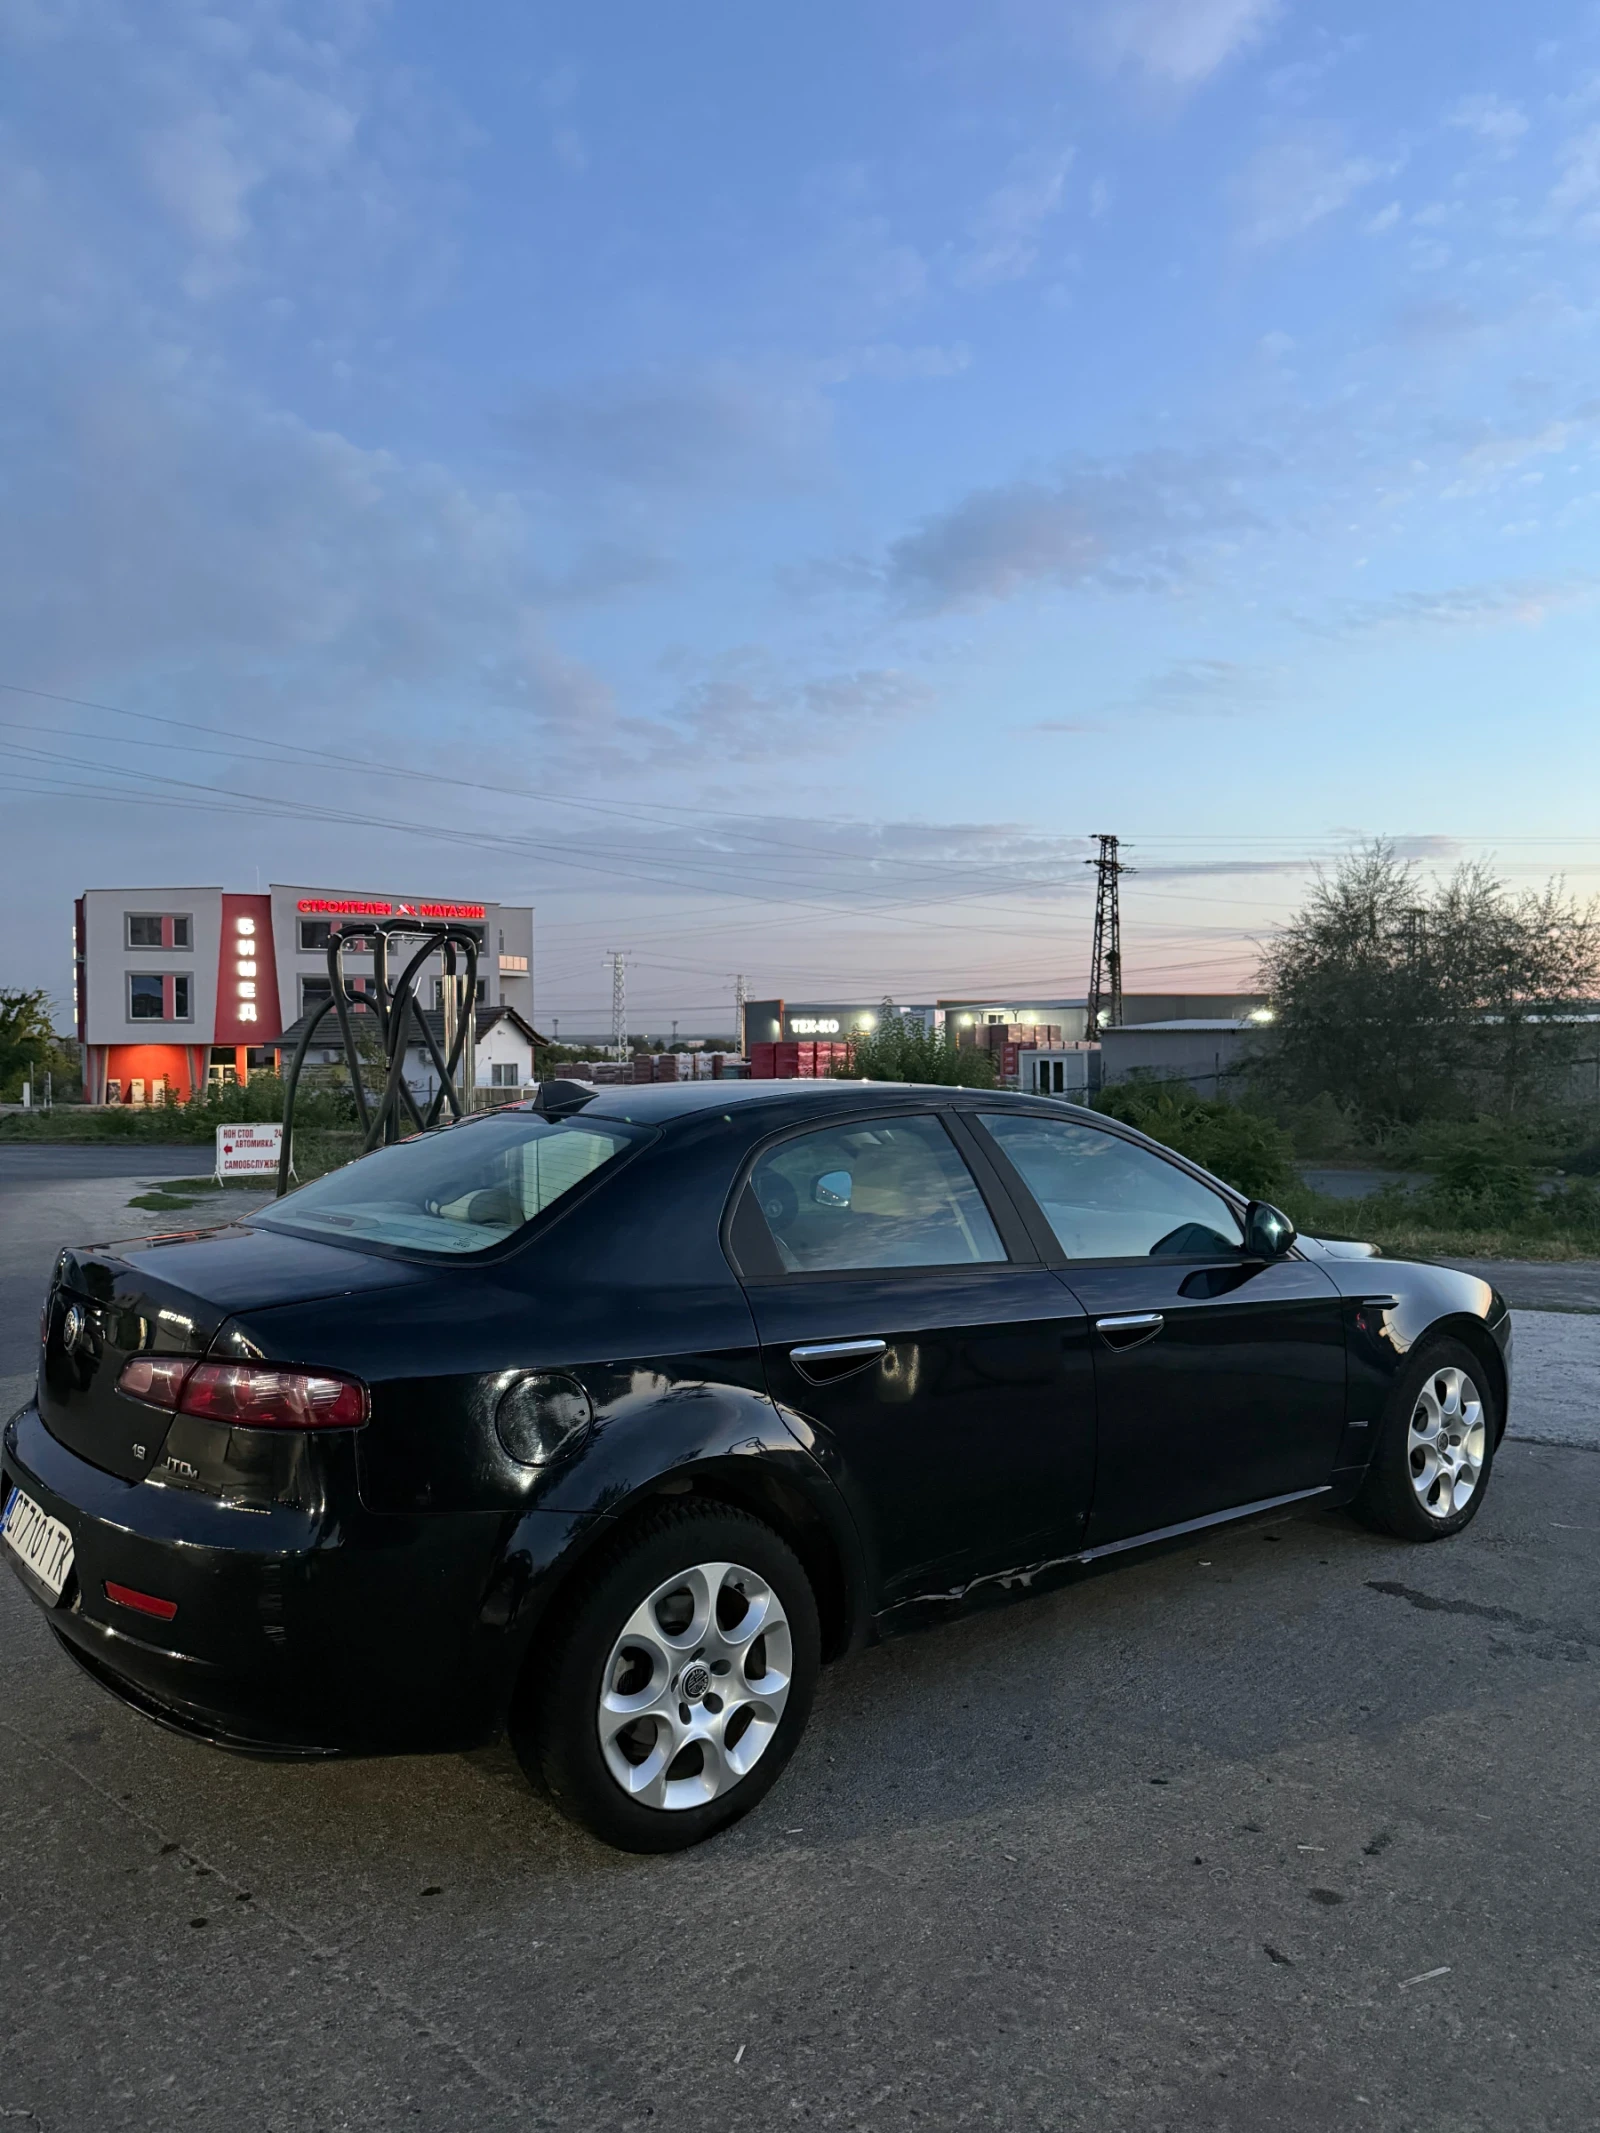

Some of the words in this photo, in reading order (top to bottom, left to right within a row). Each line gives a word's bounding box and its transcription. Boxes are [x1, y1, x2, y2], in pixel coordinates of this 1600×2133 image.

[297, 900, 392, 915] СТРОИТЕЛЕН
[419, 904, 485, 918] МАГАЗИН
[223, 1129, 236, 1138] НОН
[238, 1129, 253, 1138] СТОП
[224, 1160, 280, 1169] САМООБСЛУЖВА
